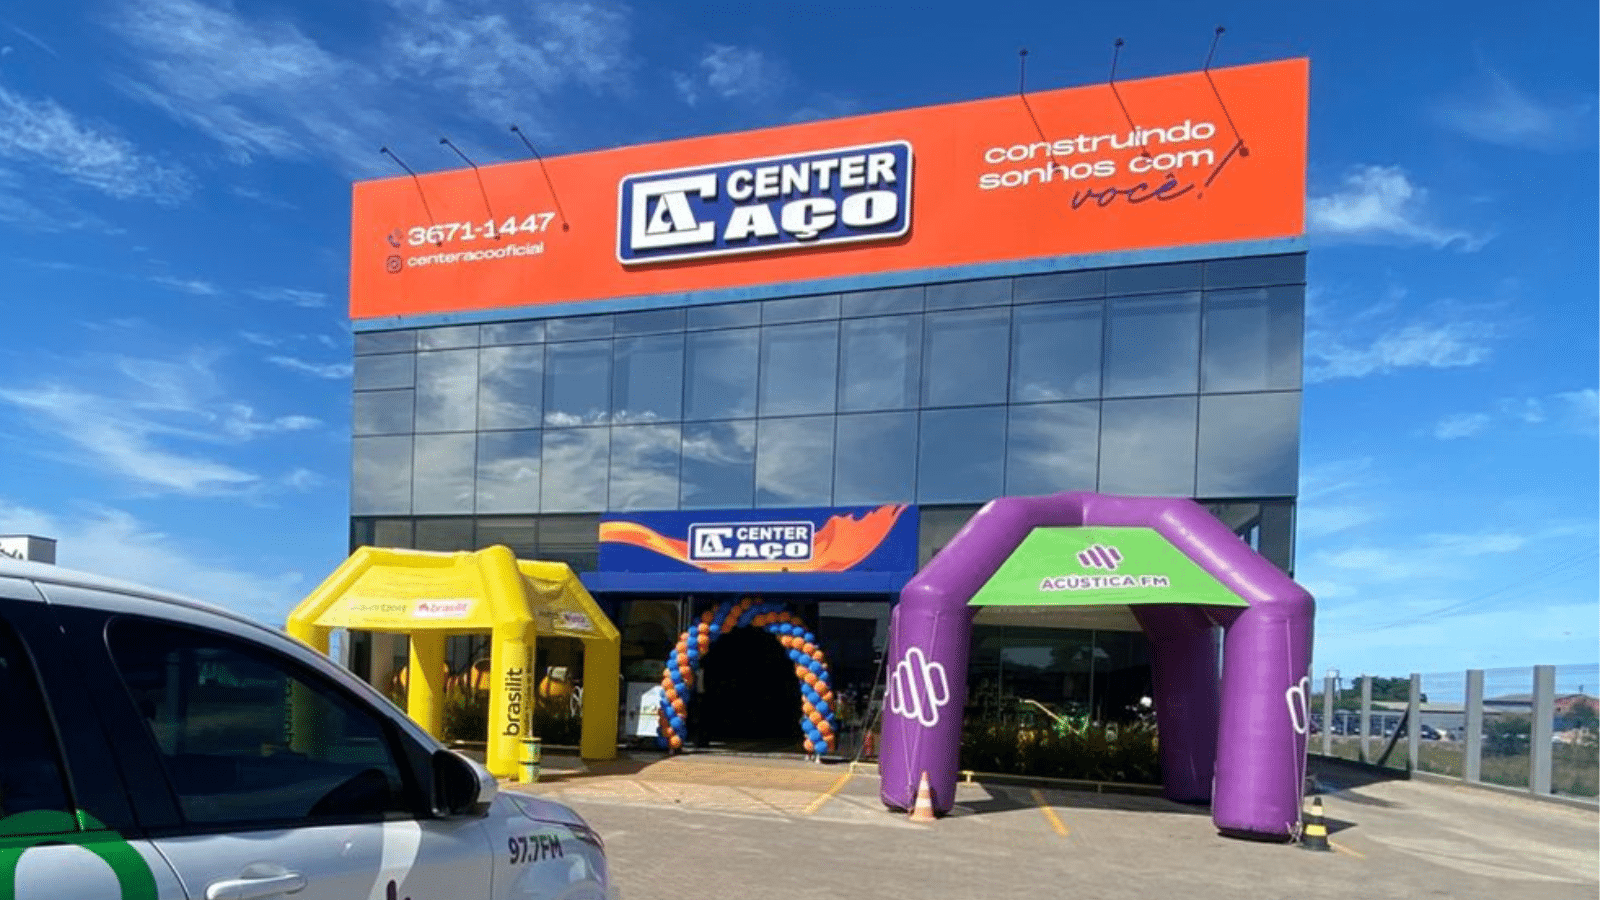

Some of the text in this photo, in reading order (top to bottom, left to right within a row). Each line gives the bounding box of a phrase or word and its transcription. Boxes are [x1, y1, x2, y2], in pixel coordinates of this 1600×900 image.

[984, 119, 1216, 164] construindo
[726, 152, 896, 200] CENTER
[978, 146, 1215, 190] sonhos com
[407, 211, 556, 246] 3671-1447
[723, 189, 898, 239] AÇO
[407, 241, 545, 268] centeracooficial
[734, 541, 809, 560] AÇO
[736, 526, 809, 541] CENTER
[1141, 576, 1168, 587] FM
[502, 667, 522, 736] brasilit
[508, 834, 564, 865] 97.7FM
